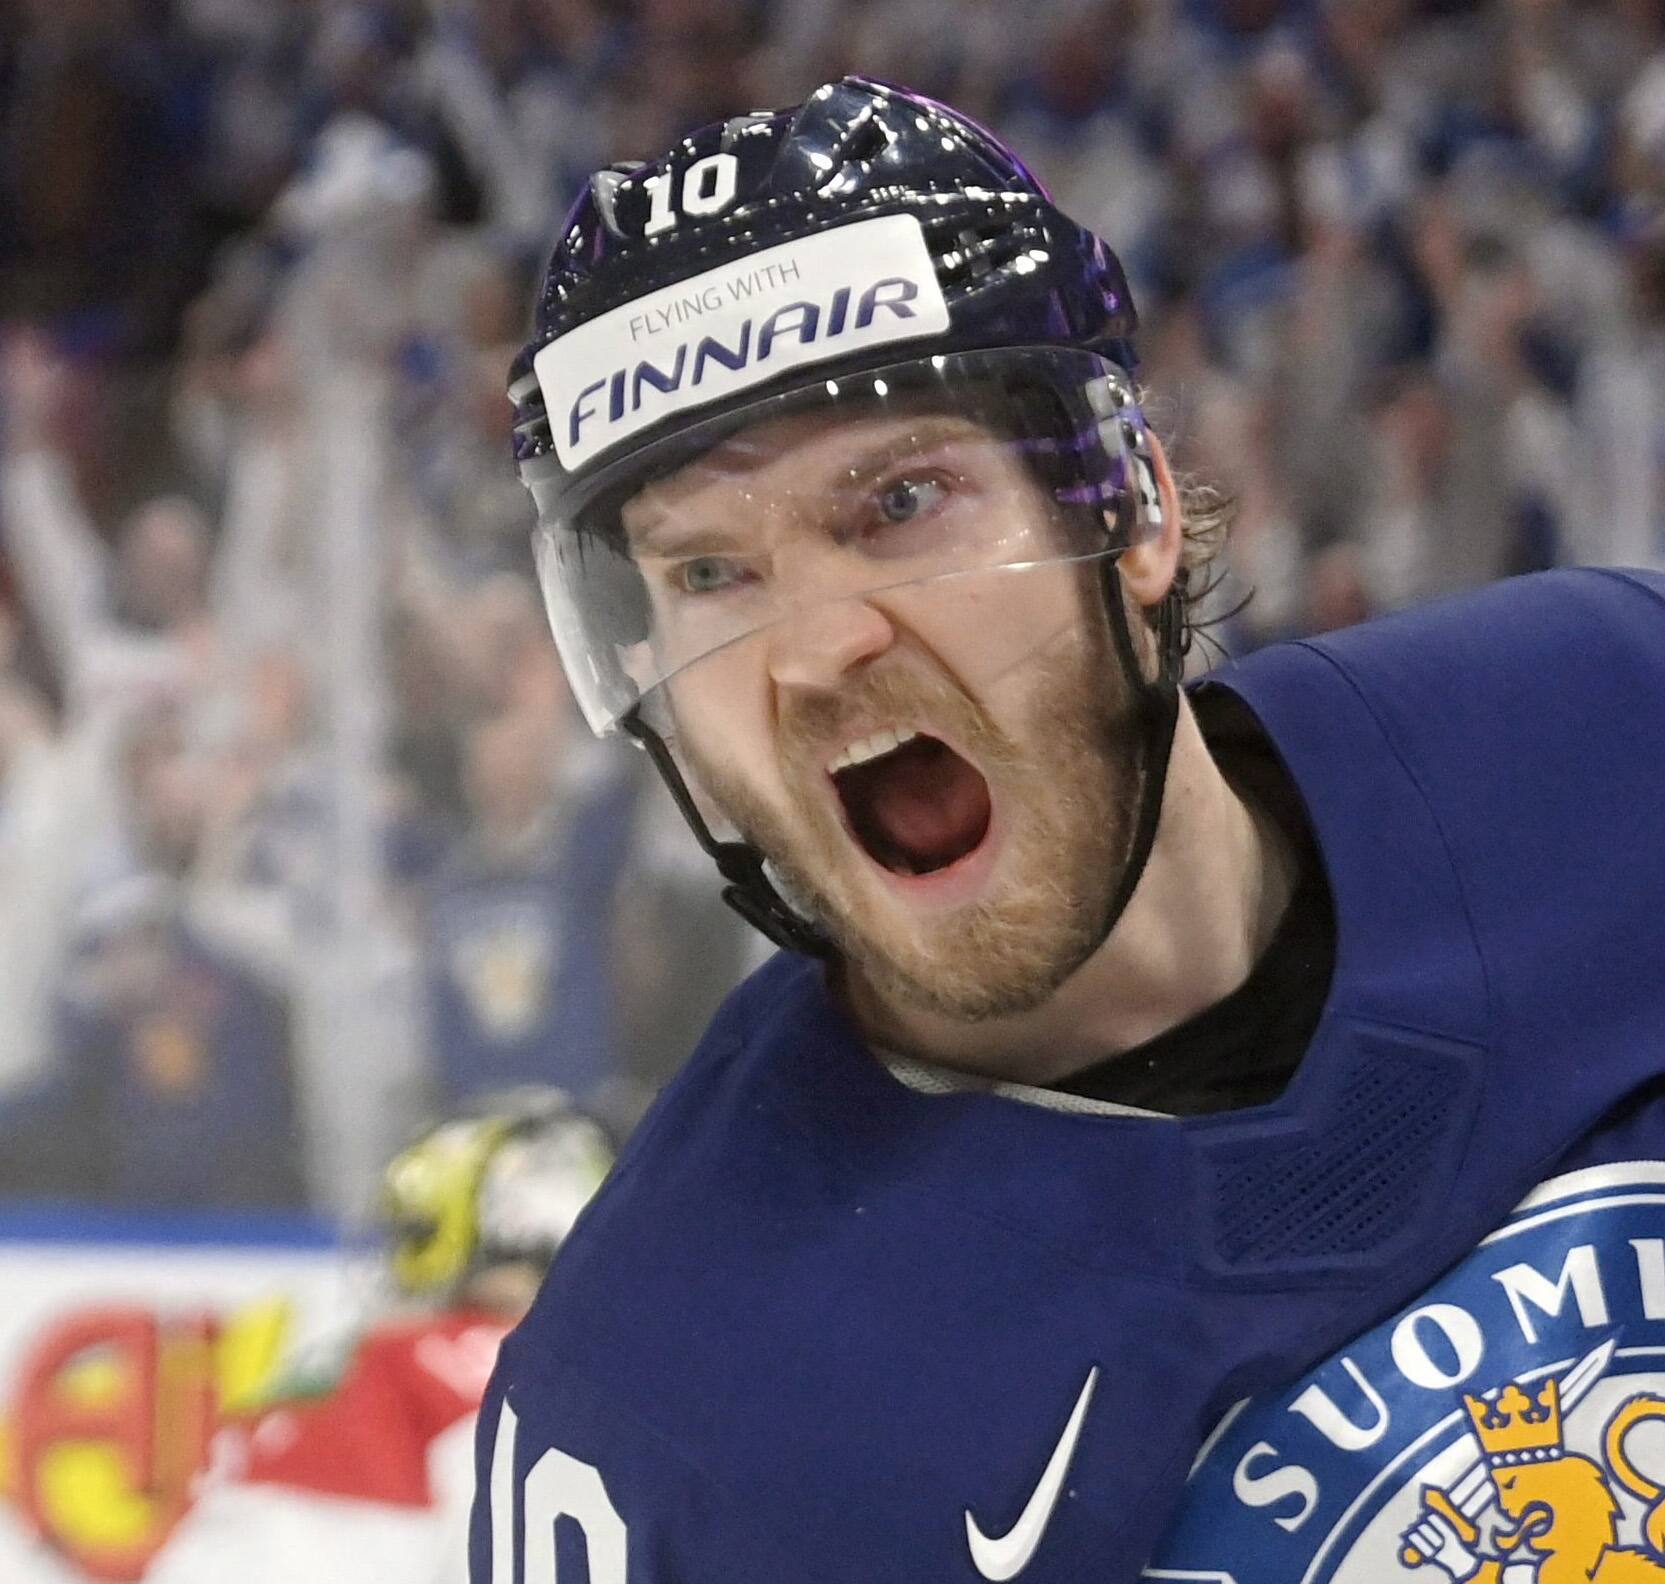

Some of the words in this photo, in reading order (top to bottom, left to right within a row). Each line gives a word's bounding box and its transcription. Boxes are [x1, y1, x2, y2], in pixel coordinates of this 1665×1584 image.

[643, 152, 739, 236] 10
[629, 286, 724, 341] FLYING
[727, 259, 801, 303] WITH
[569, 276, 919, 448] FINNAIR
